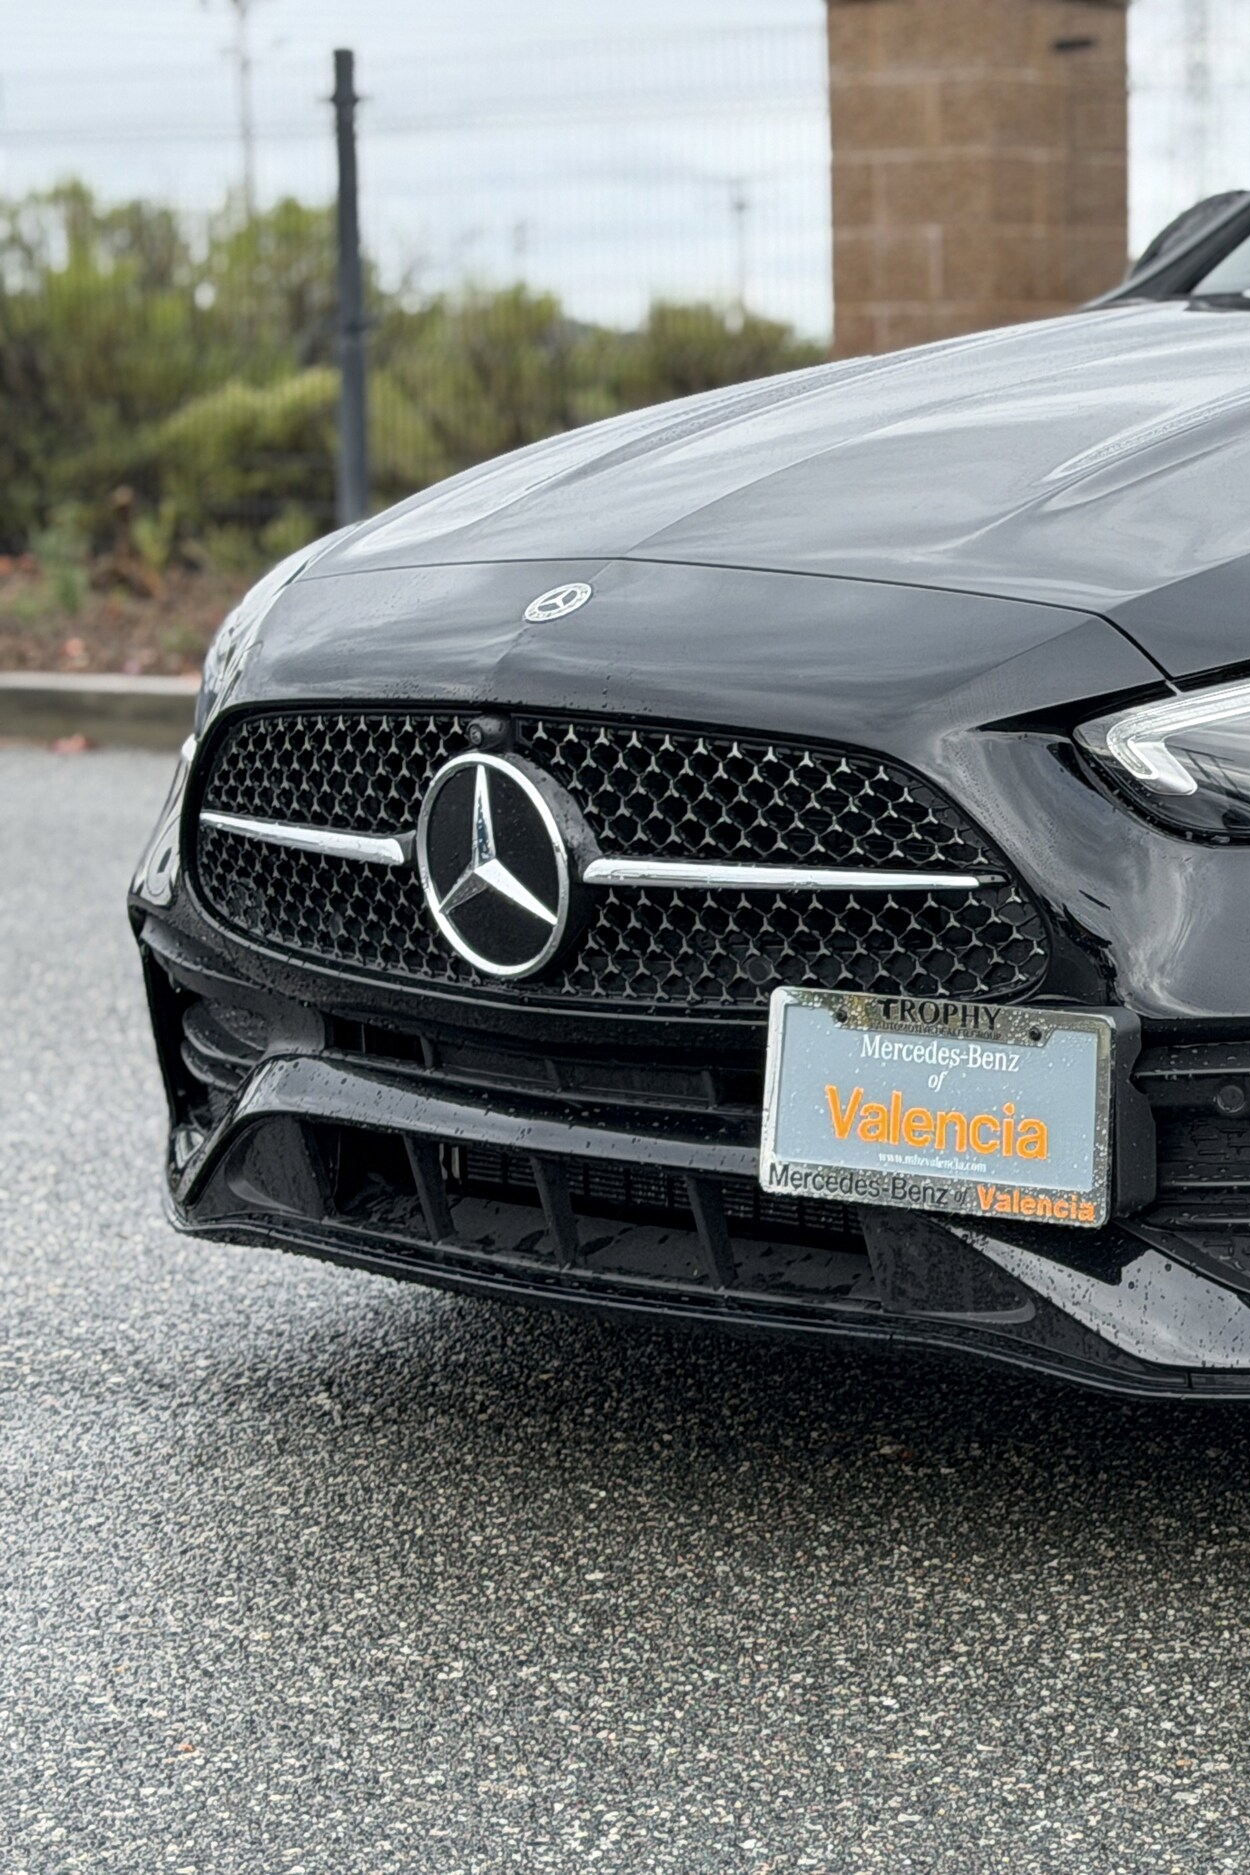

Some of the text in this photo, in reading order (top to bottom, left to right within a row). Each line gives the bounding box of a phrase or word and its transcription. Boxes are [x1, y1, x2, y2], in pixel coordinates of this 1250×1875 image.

[877, 999, 1001, 1031] TROPHY
[860, 1034, 1020, 1072] Mercedes-Benz
[928, 1071, 948, 1092] of
[825, 1084, 1049, 1160] Valencia
[768, 1162, 1097, 1222] Mercedes-Benz of Valencia
